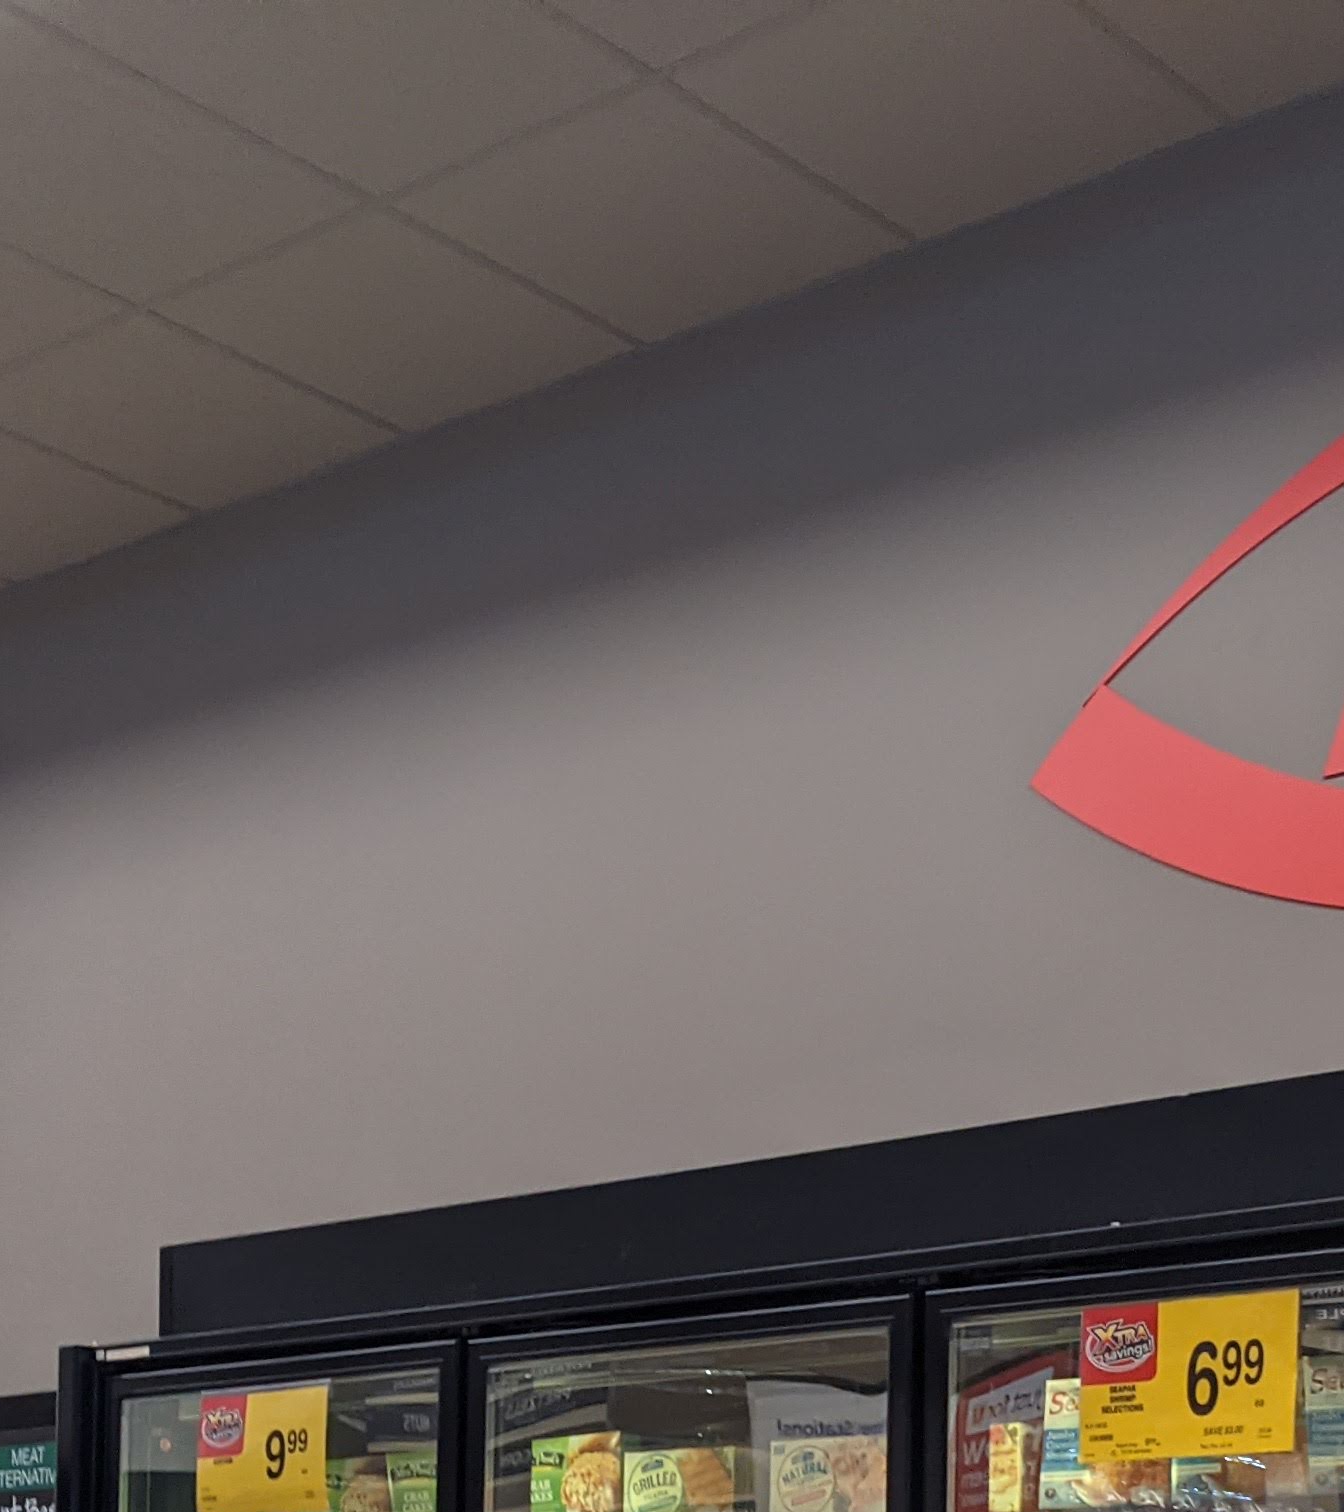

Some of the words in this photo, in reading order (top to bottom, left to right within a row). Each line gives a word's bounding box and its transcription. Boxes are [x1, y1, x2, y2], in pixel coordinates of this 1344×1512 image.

[1186, 1337, 1265, 1417] 699
[10, 1446, 46, 1467] MEAT
[264, 1428, 308, 1480] 999
[631, 1471, 678, 1496] GRILLED
